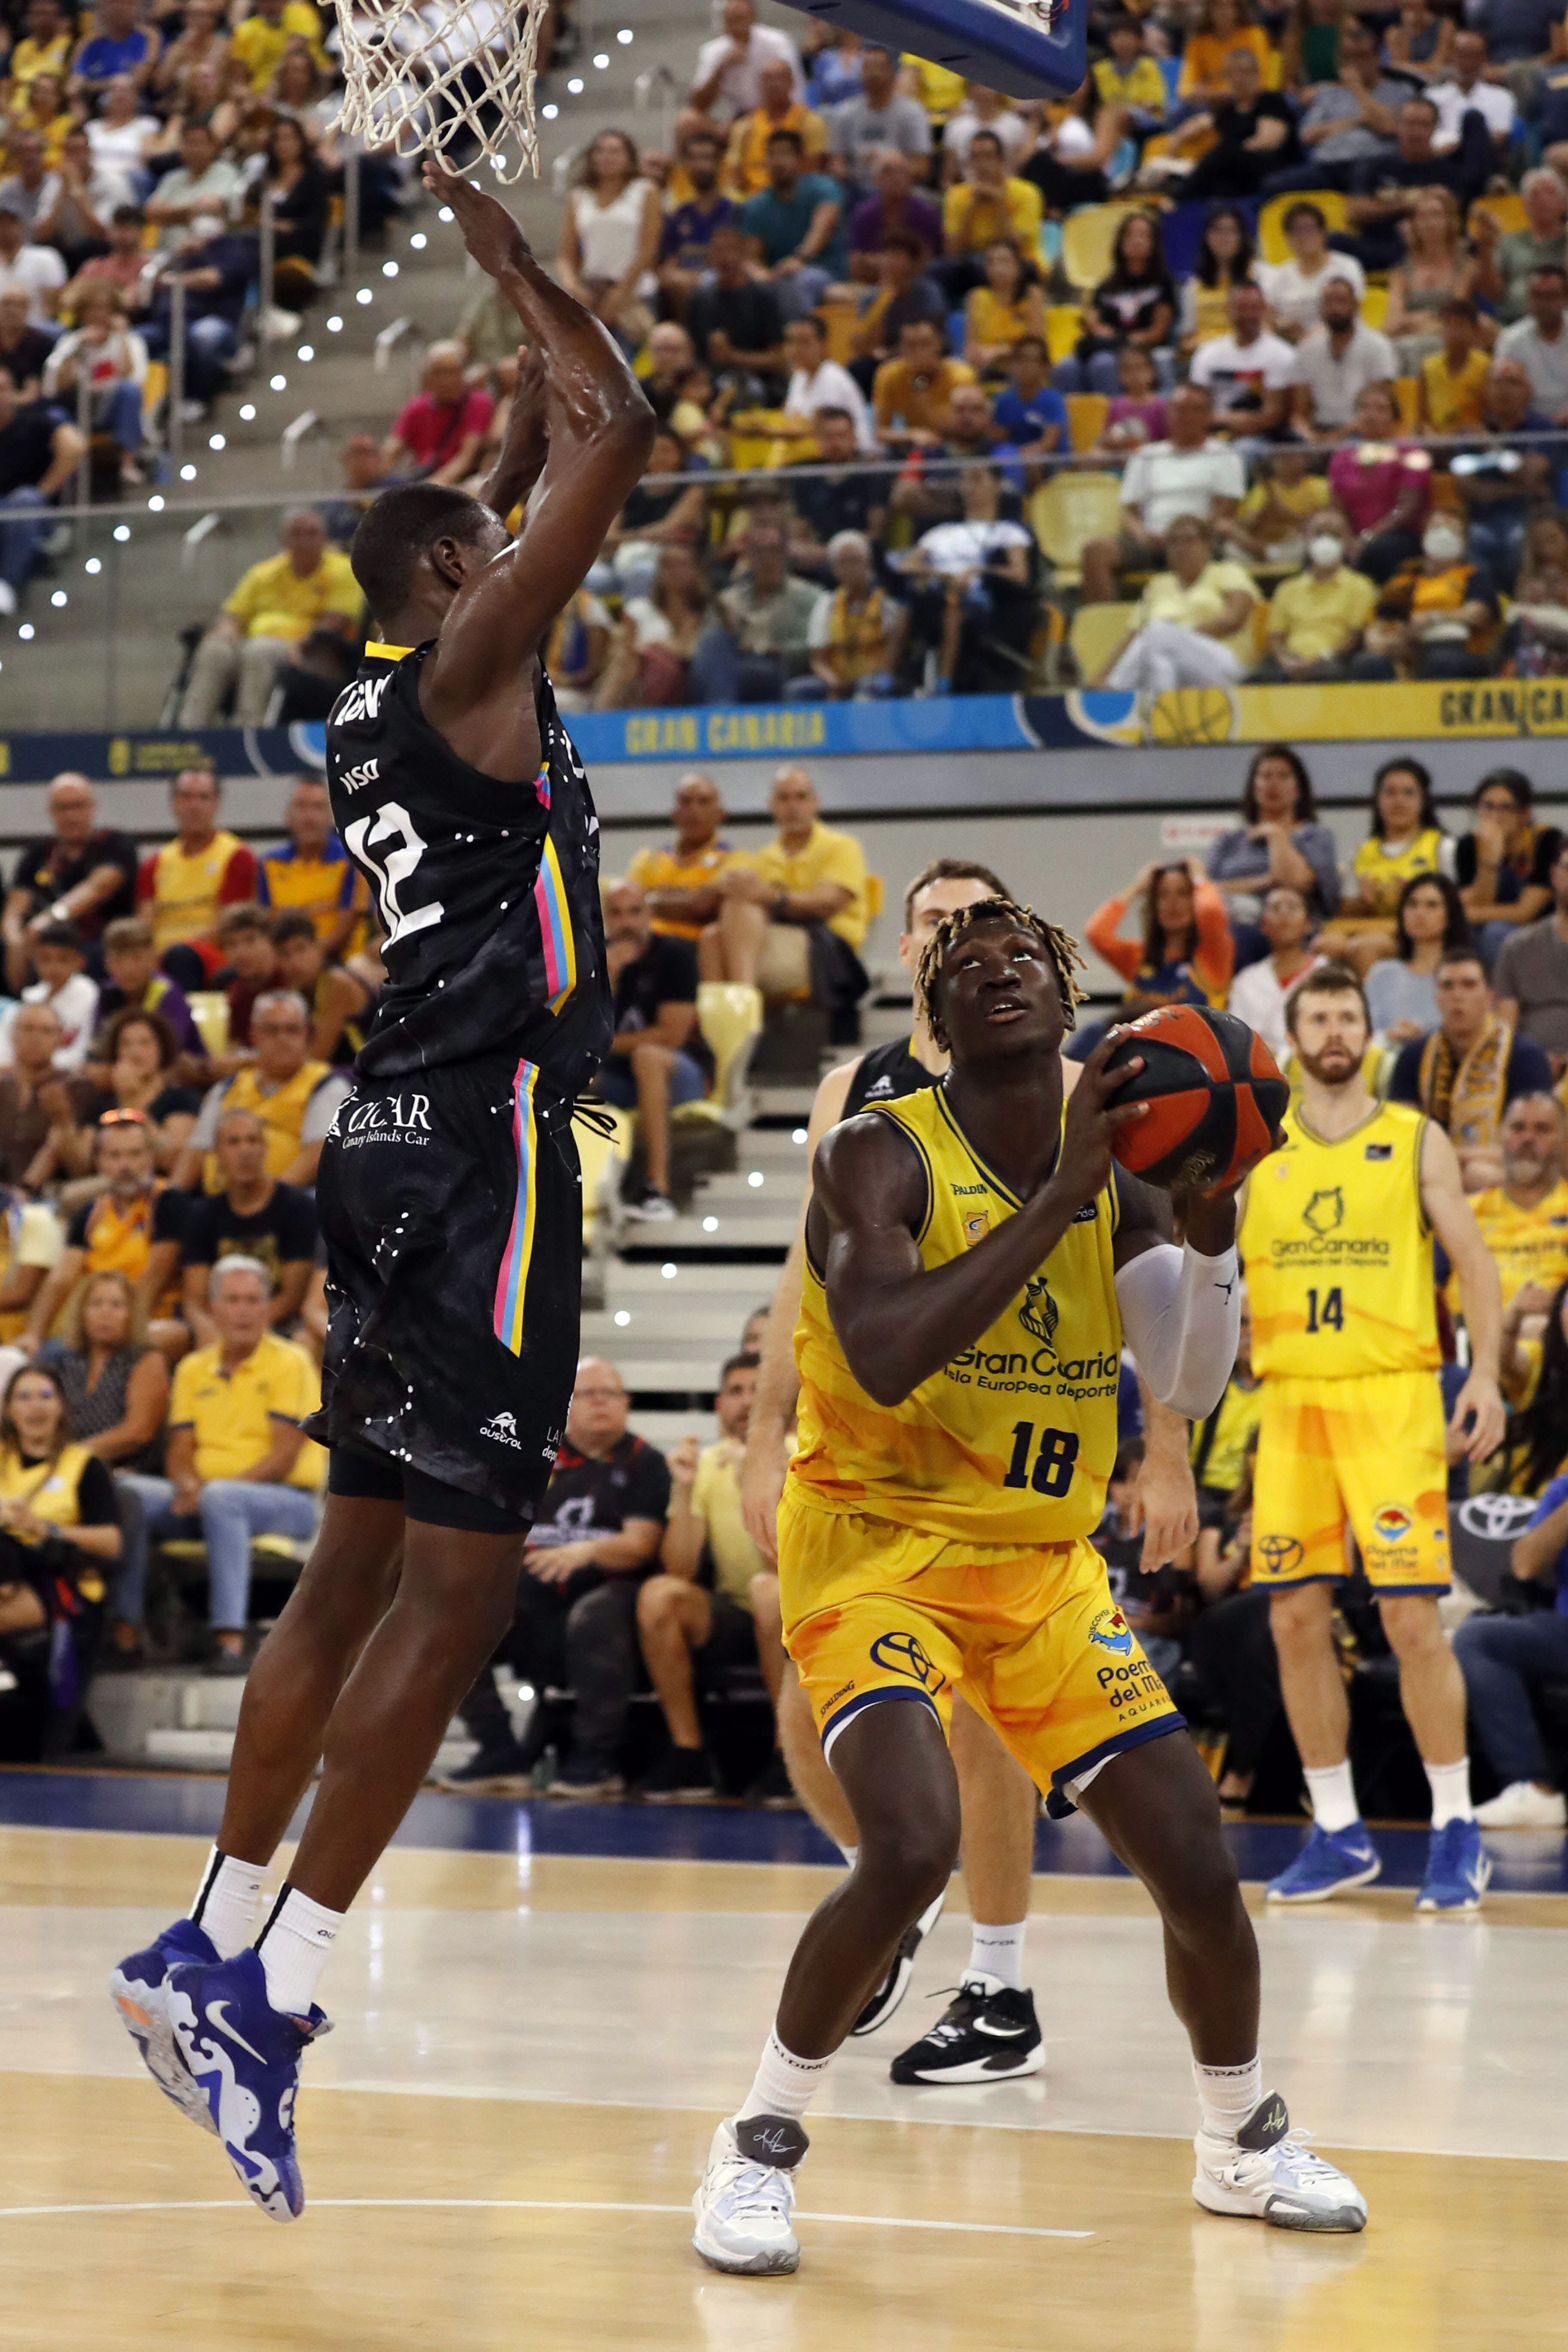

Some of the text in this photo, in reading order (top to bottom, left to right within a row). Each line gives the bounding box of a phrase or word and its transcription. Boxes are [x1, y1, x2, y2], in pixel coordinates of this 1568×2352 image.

[1440, 690, 1516, 726] GRAN
[626, 715, 698, 755] GRAN
[707, 709, 825, 751] CANARIA
[405, 1131, 430, 1146] Car
[1305, 1287, 1344, 1333] 14
[977, 1375, 1051, 1395] Europea
[479, 1427, 522, 1451] austral
[1003, 1421, 1080, 1498] 18
[1096, 1660, 1150, 1689] Poem
[1110, 1681, 1142, 1708] del
[1118, 1696, 1173, 1722] AQUARI
